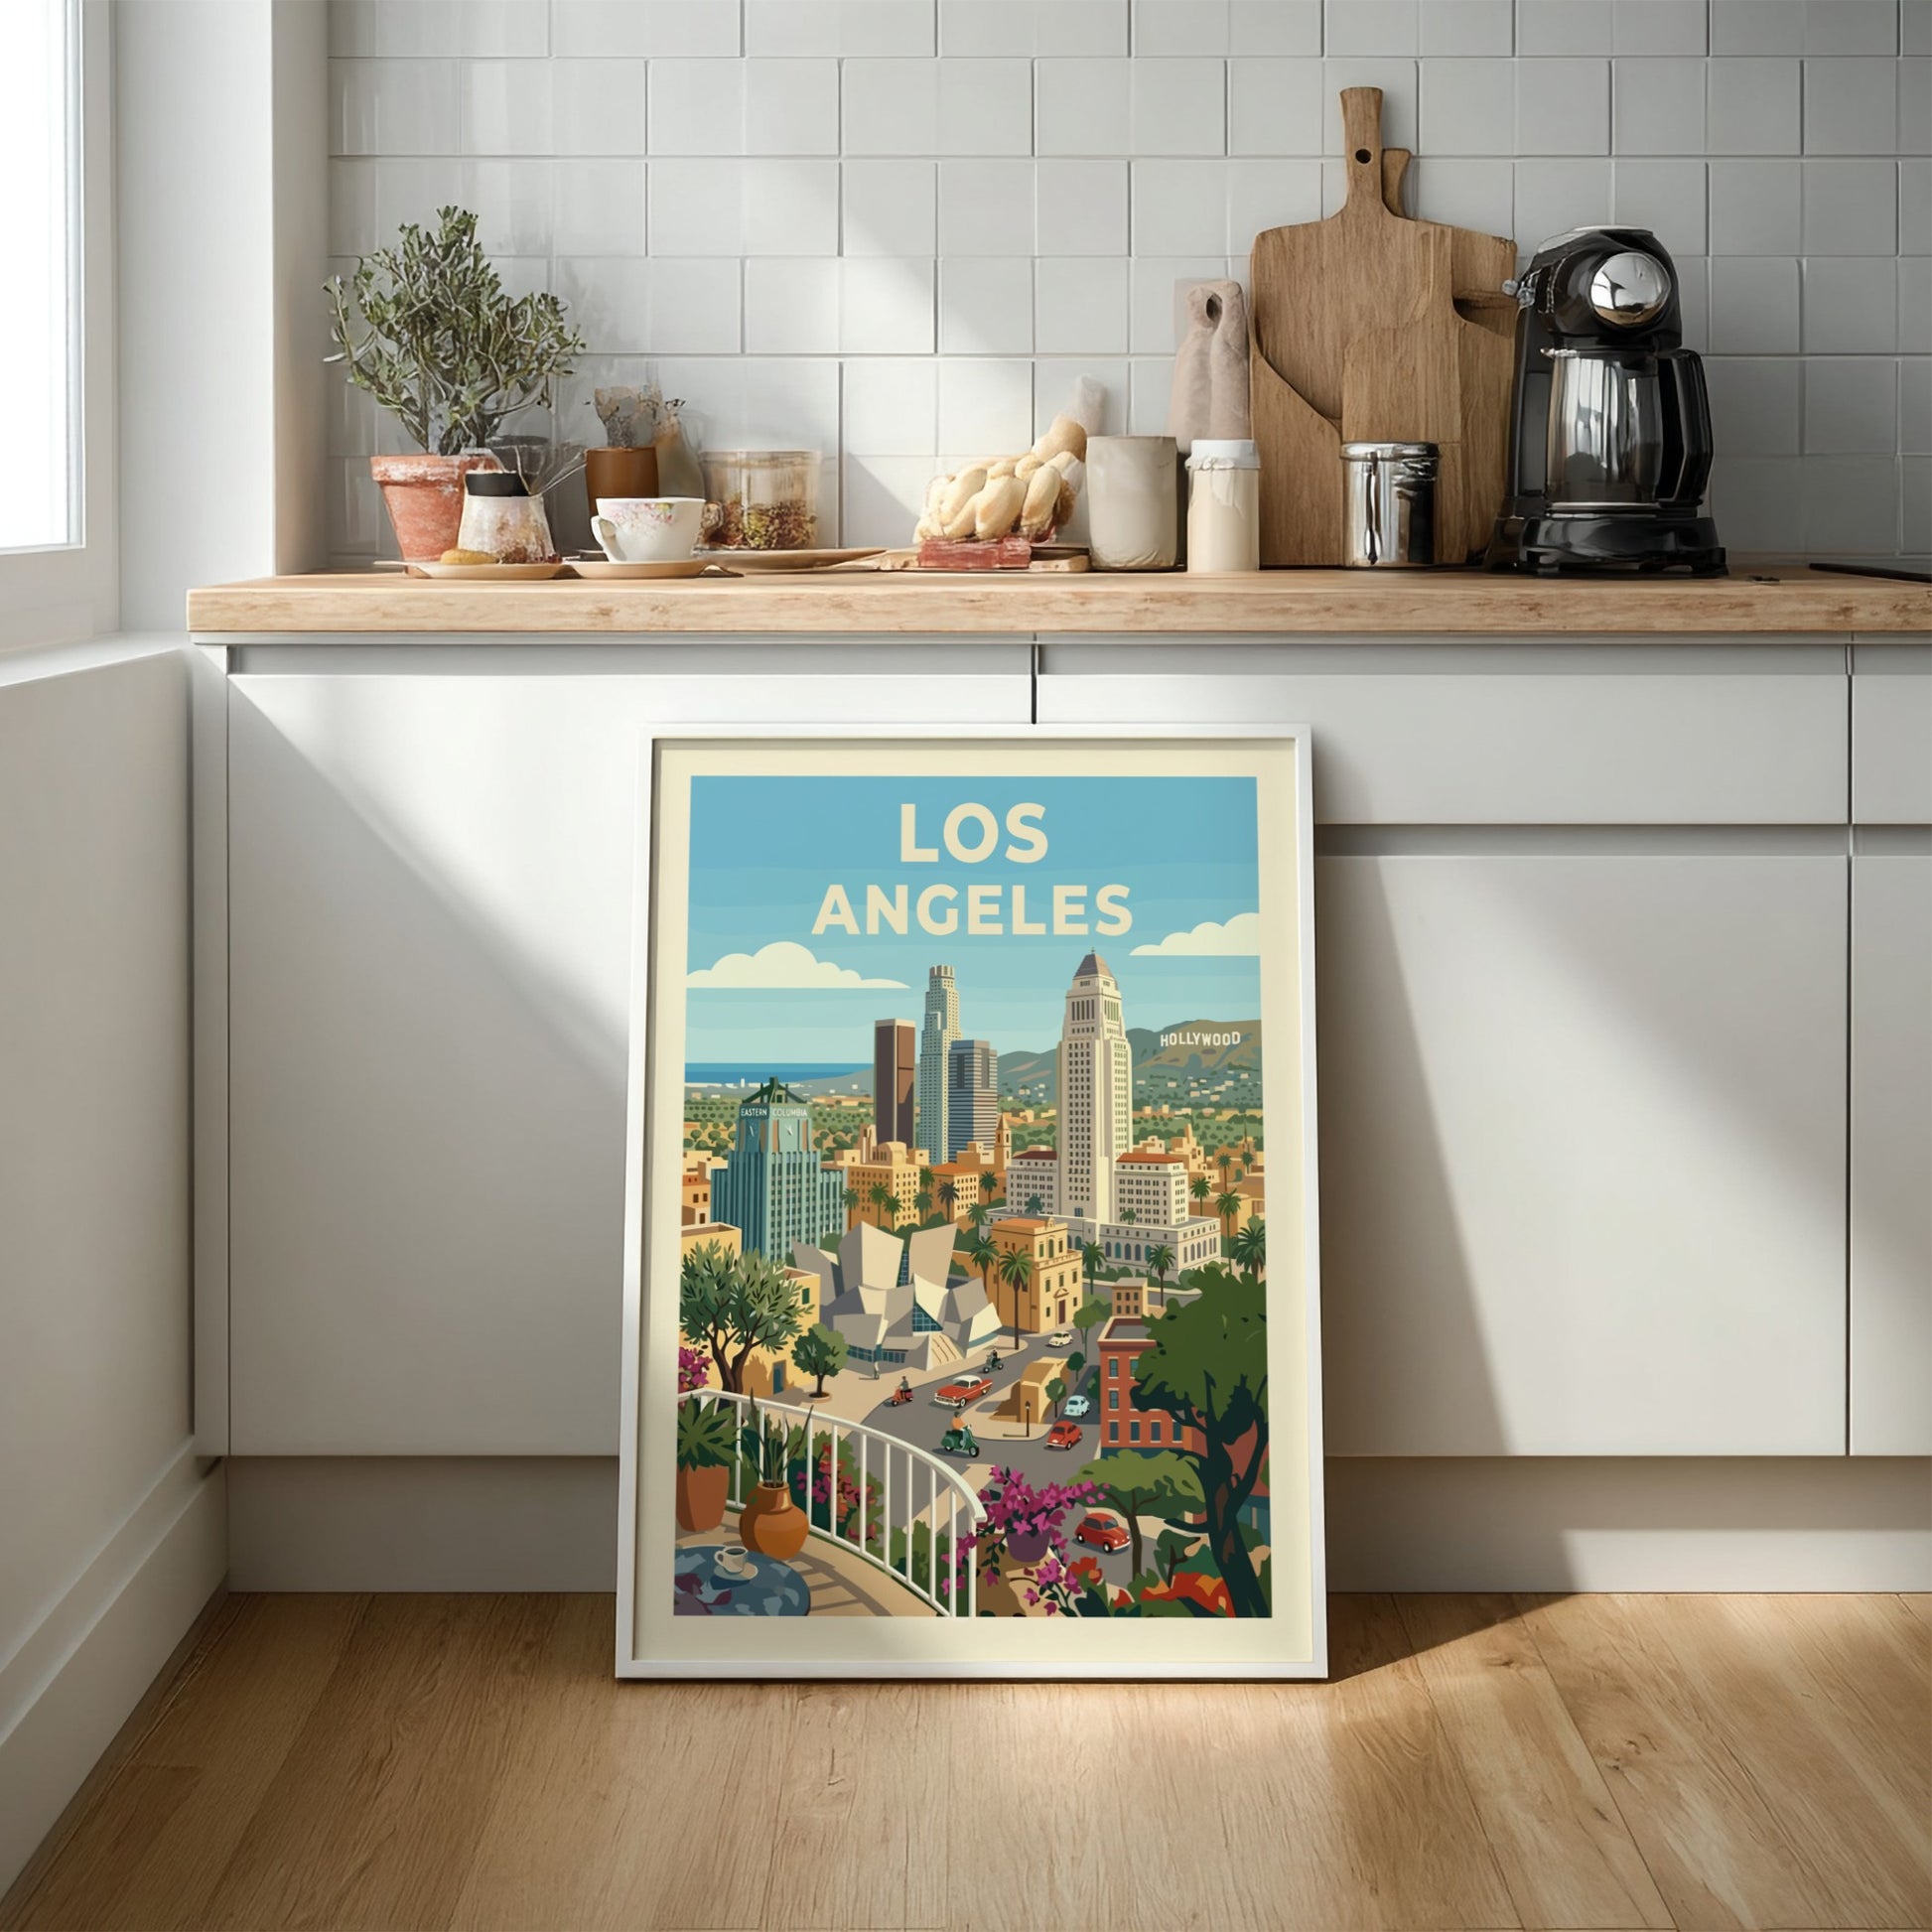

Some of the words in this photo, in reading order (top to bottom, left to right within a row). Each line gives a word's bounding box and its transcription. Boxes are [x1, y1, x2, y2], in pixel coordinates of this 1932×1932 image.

[900, 802, 1048, 864] LOS
[811, 884, 1134, 936] ANGELES
[1160, 1032, 1241, 1047] HOLLYWOOD
